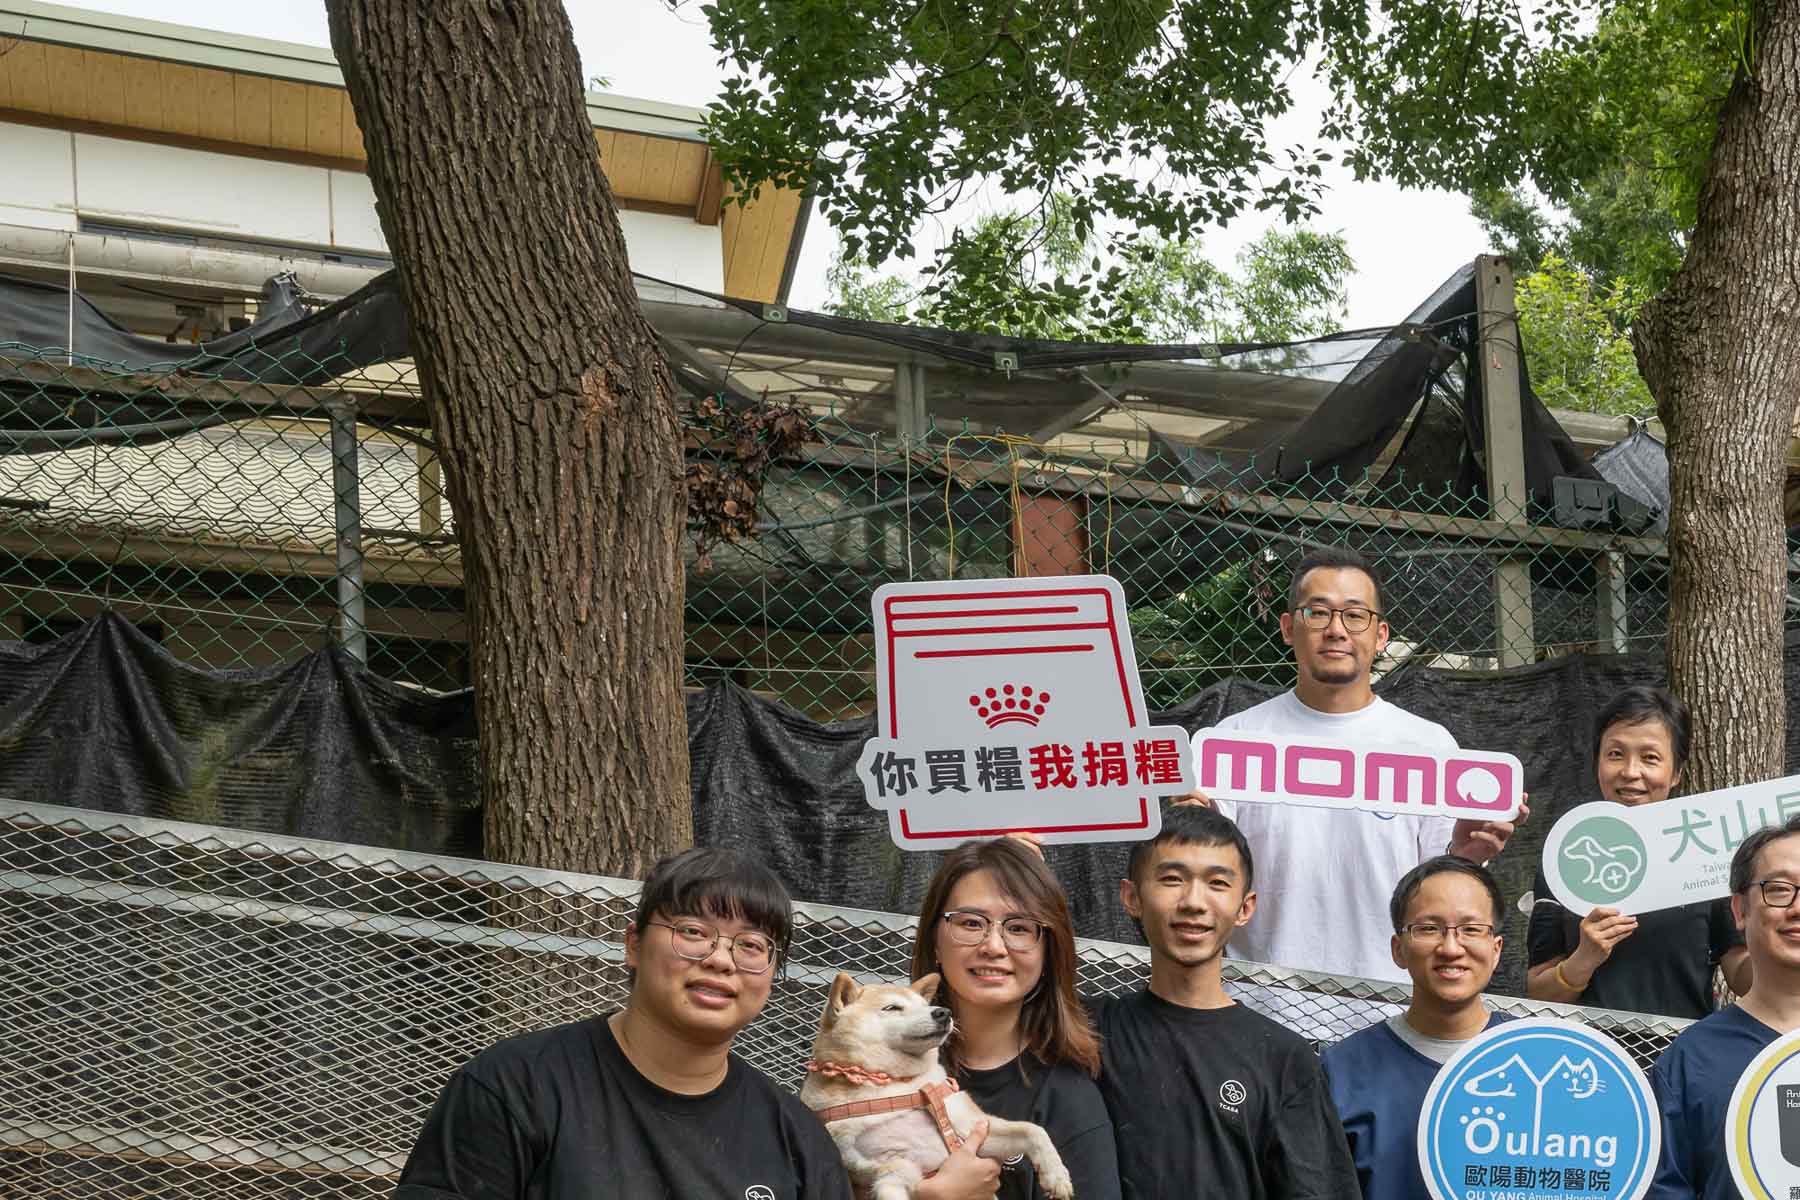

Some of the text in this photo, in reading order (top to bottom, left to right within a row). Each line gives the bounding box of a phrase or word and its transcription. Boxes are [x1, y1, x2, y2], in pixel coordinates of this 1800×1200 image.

[870, 739, 1184, 797] 你買糧我捐糧
[1201, 738, 1513, 811] momo
[1682, 875, 1720, 890] Animal
[1464, 1164, 1611, 1192] 歐陽動物醫院
[1466, 1190, 1486, 1200] OU
